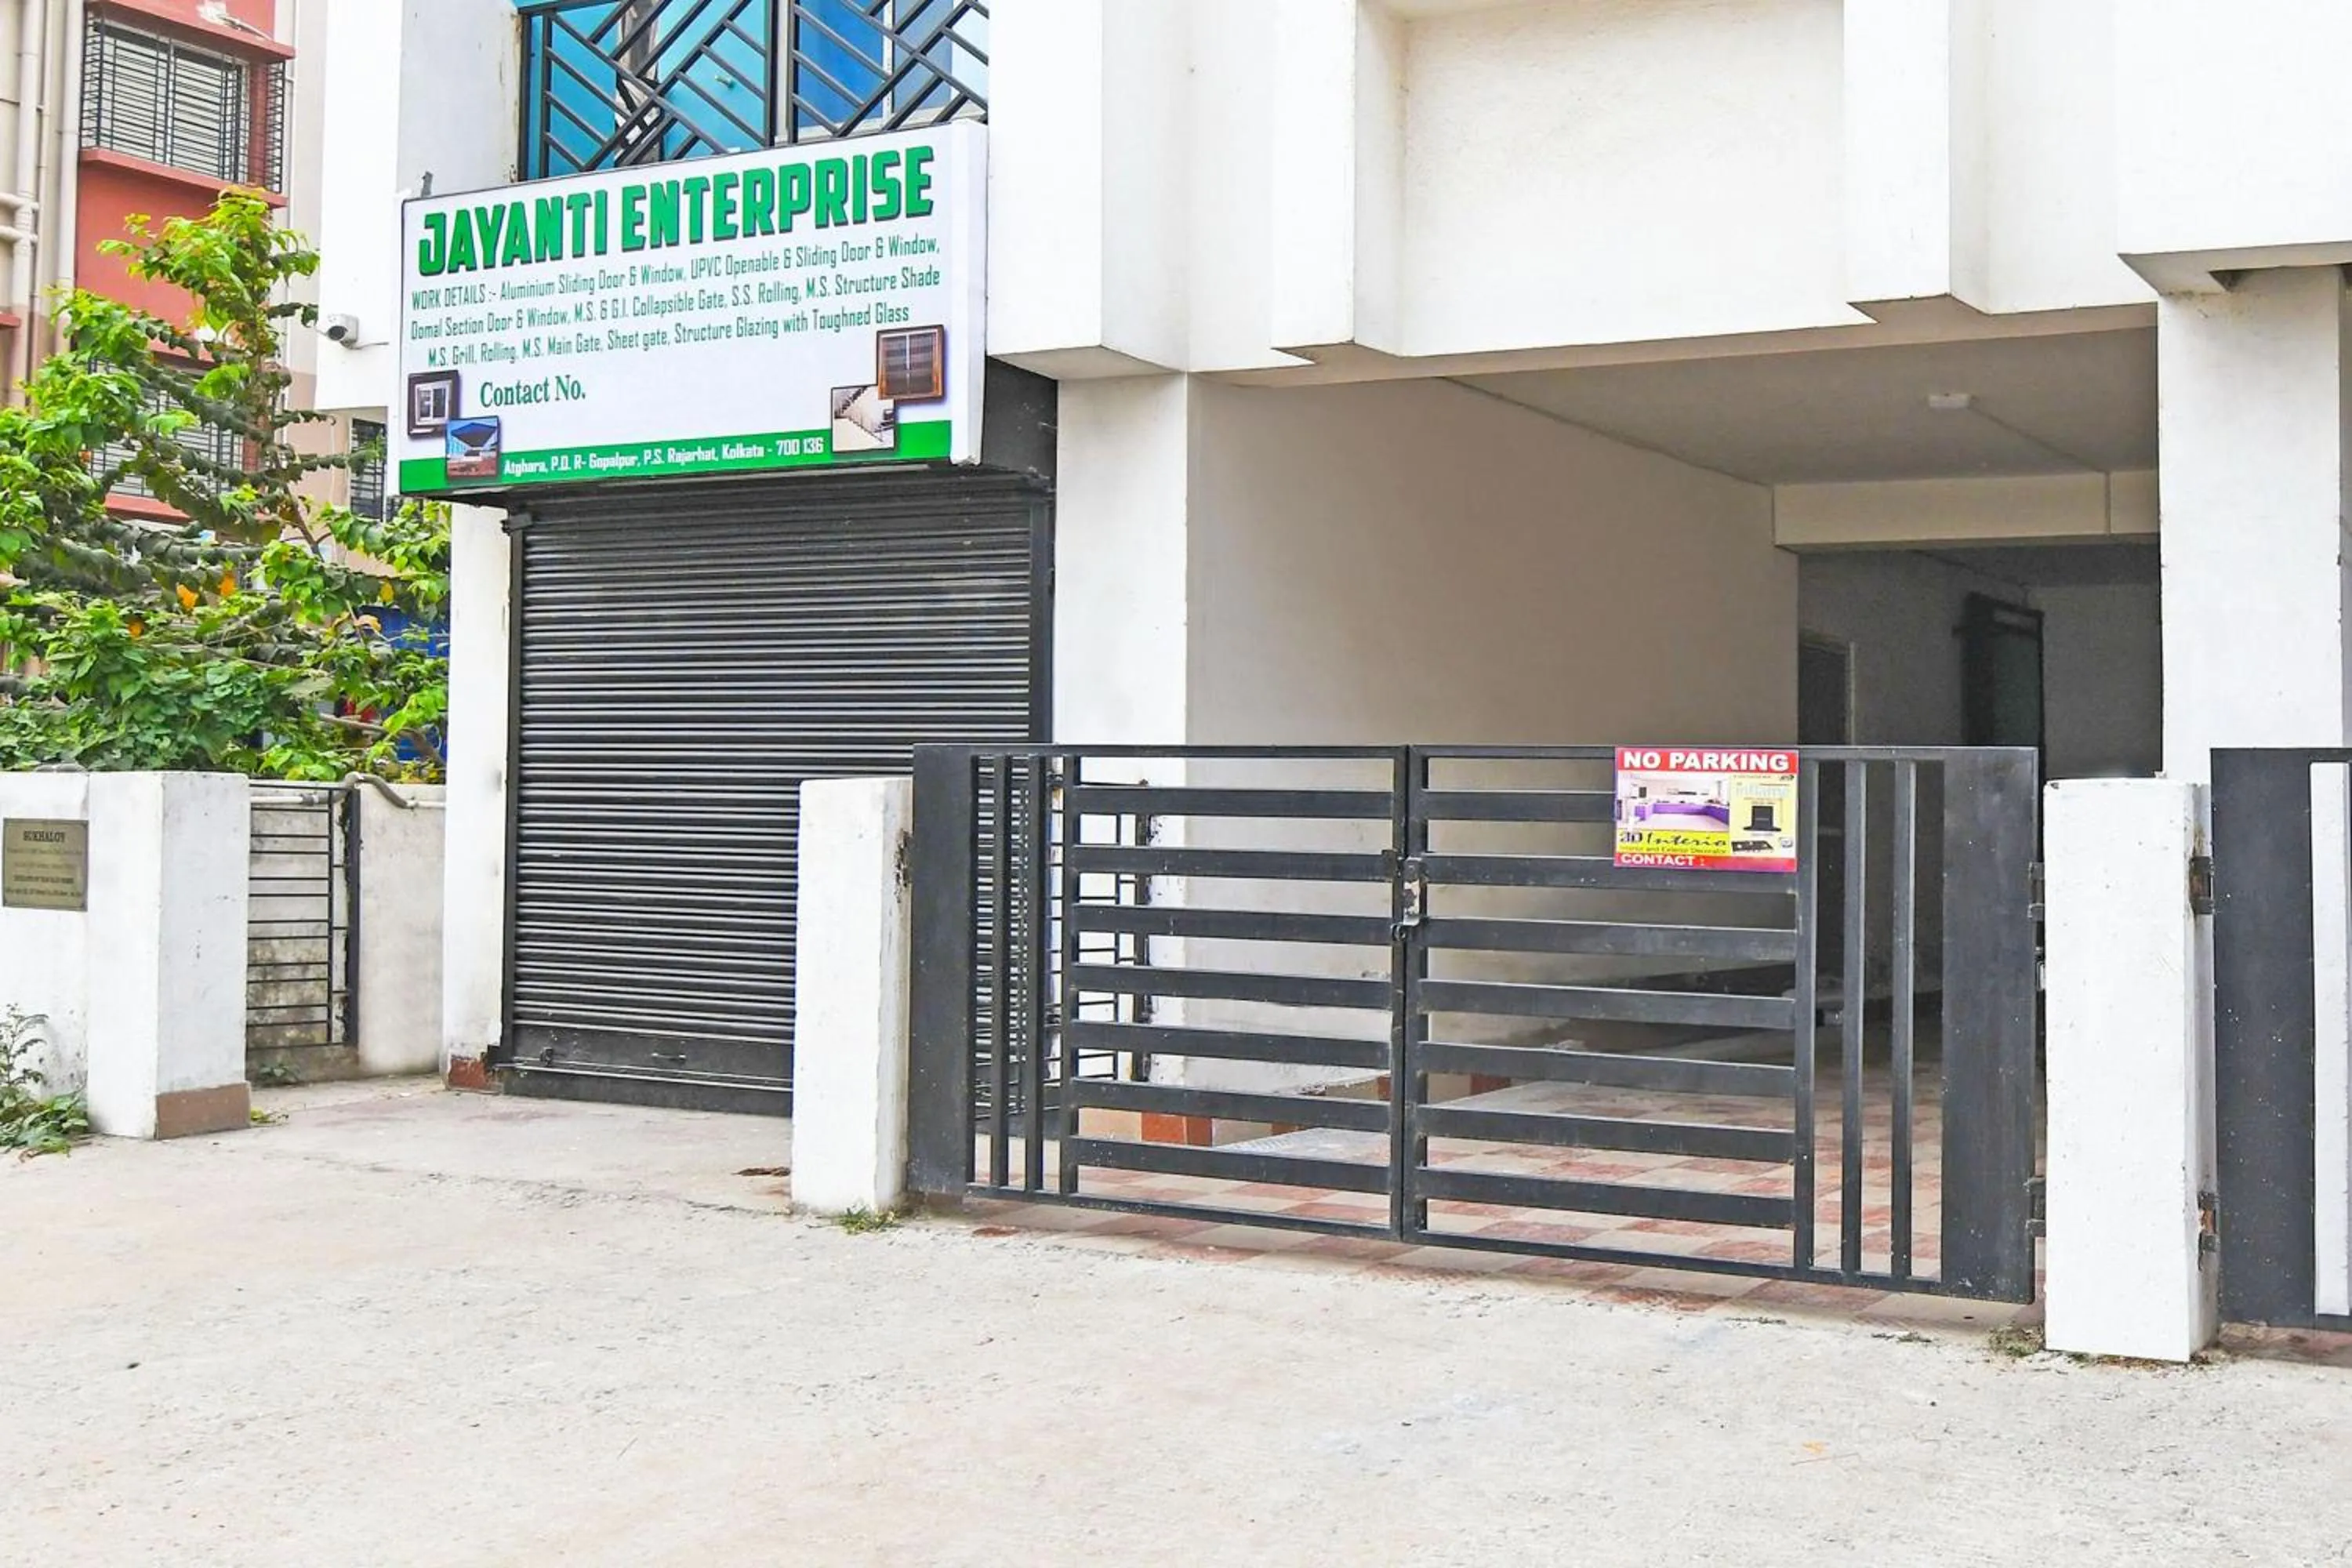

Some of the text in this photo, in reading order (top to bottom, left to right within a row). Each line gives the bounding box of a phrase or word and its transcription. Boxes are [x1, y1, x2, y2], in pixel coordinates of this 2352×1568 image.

[419, 145, 935, 276] JAYANTI ENTERPRISE
[412, 288, 441, 310] WORK
[445, 283, 485, 307] DETAILS
[500, 278, 555, 301] Aluminium
[558, 272, 594, 295] Sliding
[598, 269, 626, 289] Door
[630, 265, 637, 286] &
[641, 261, 687, 285] Window,
[691, 255, 721, 279] UPVC
[725, 249, 779, 280] Openable
[783, 248, 791, 269] &
[796, 243, 837, 268] Sliding
[841, 241, 870, 263] Door
[876, 237, 884, 258] &
[888, 232, 940, 257] Window,
[411, 264, 941, 339] Domal Section Door & Window, M.S. & G.I. Collapsible Gate, S.S. Rolling, M.S. Structure Shade
[428, 301, 909, 368] M.S. Grill, Rolling, M.S. Main Gate, Sheet gate, Structure Glazing with Toughned Glass
[480, 374, 586, 408] Contact No.
[589, 452, 641, 471] Gopalpur,
[643, 448, 665, 466] P.S.
[722, 442, 764, 460] Kolkata
[775, 438, 800, 456] 700
[803, 437, 824, 454] 136
[1623, 750, 1790, 771] NO PARKING
[1620, 853, 1696, 866] CONTACT
